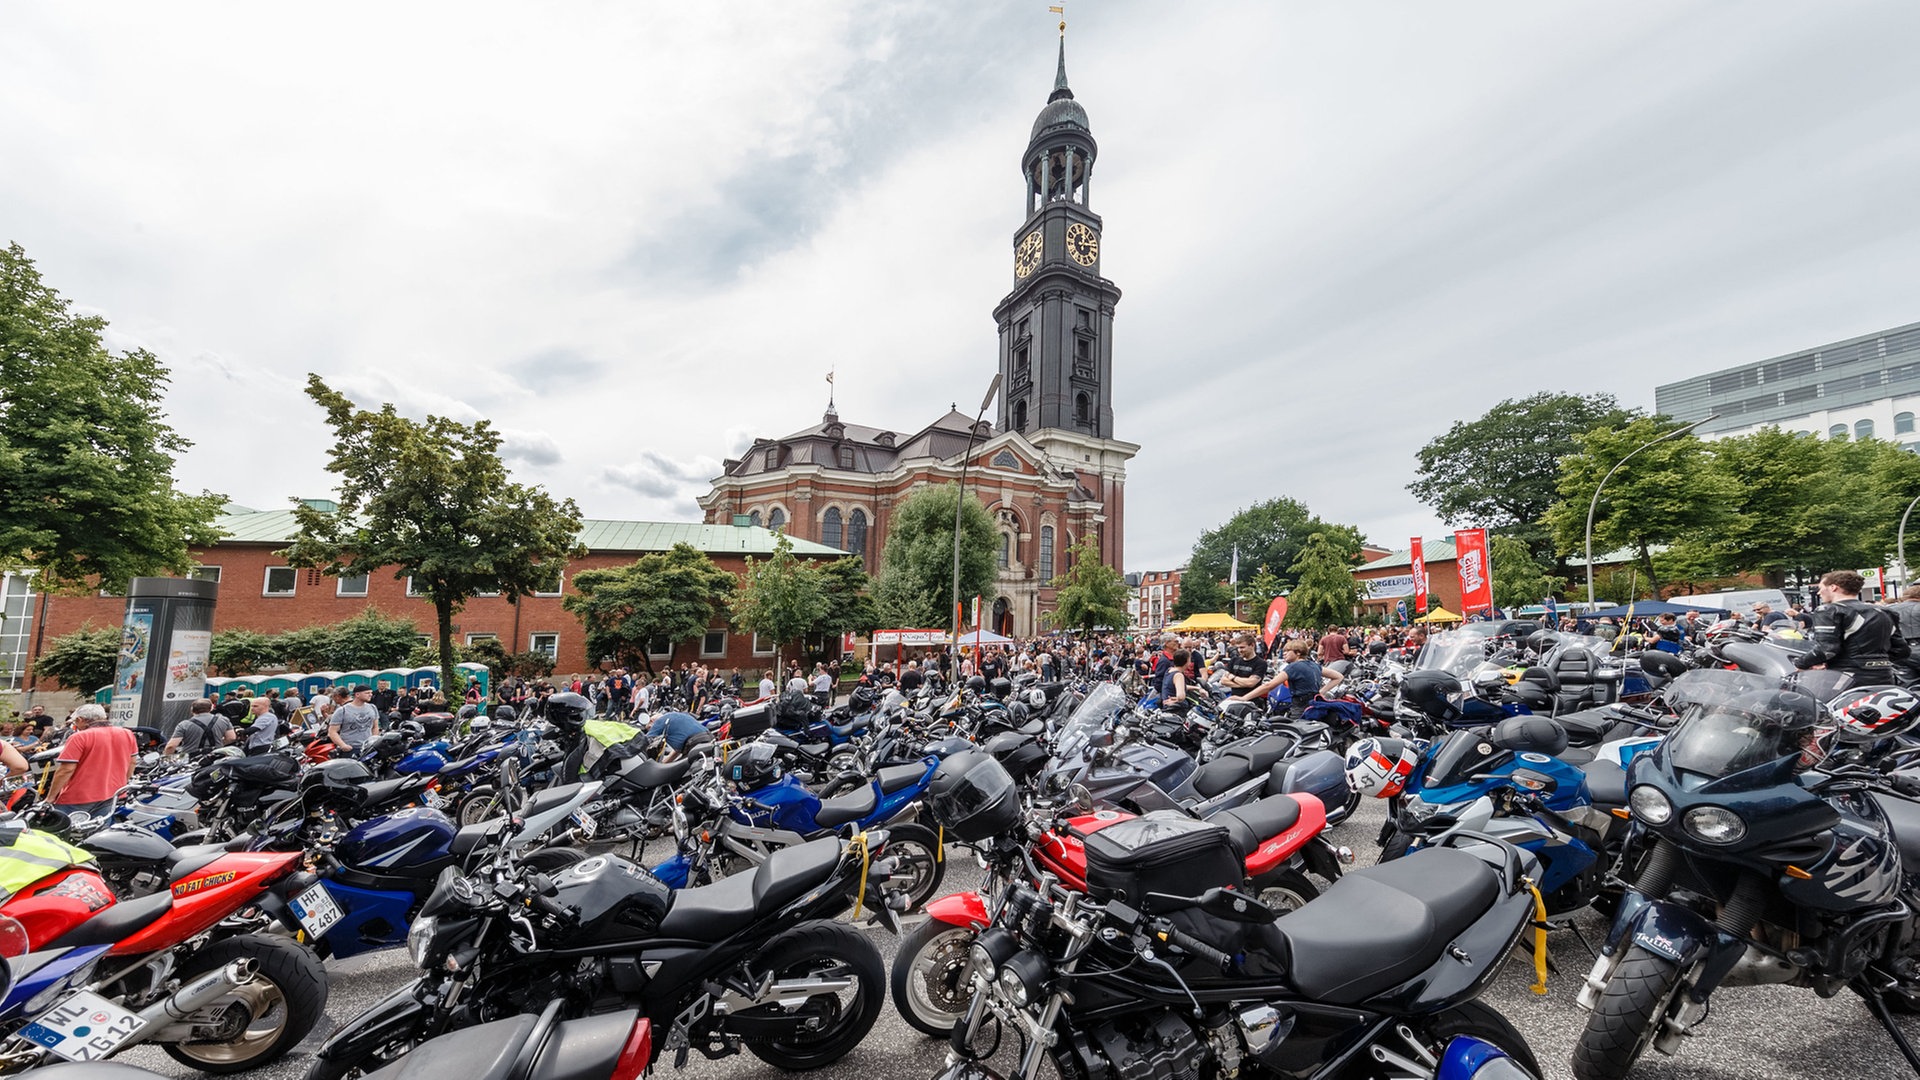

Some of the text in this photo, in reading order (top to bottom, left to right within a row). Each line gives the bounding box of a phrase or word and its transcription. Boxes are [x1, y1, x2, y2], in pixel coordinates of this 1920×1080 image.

[174, 872, 234, 896] NO FAT CHICKS
[301, 889, 319, 907] HH
[308, 907, 338, 936] F 487
[44, 1006, 88, 1027] WL
[45, 1035, 57, 1043] D
